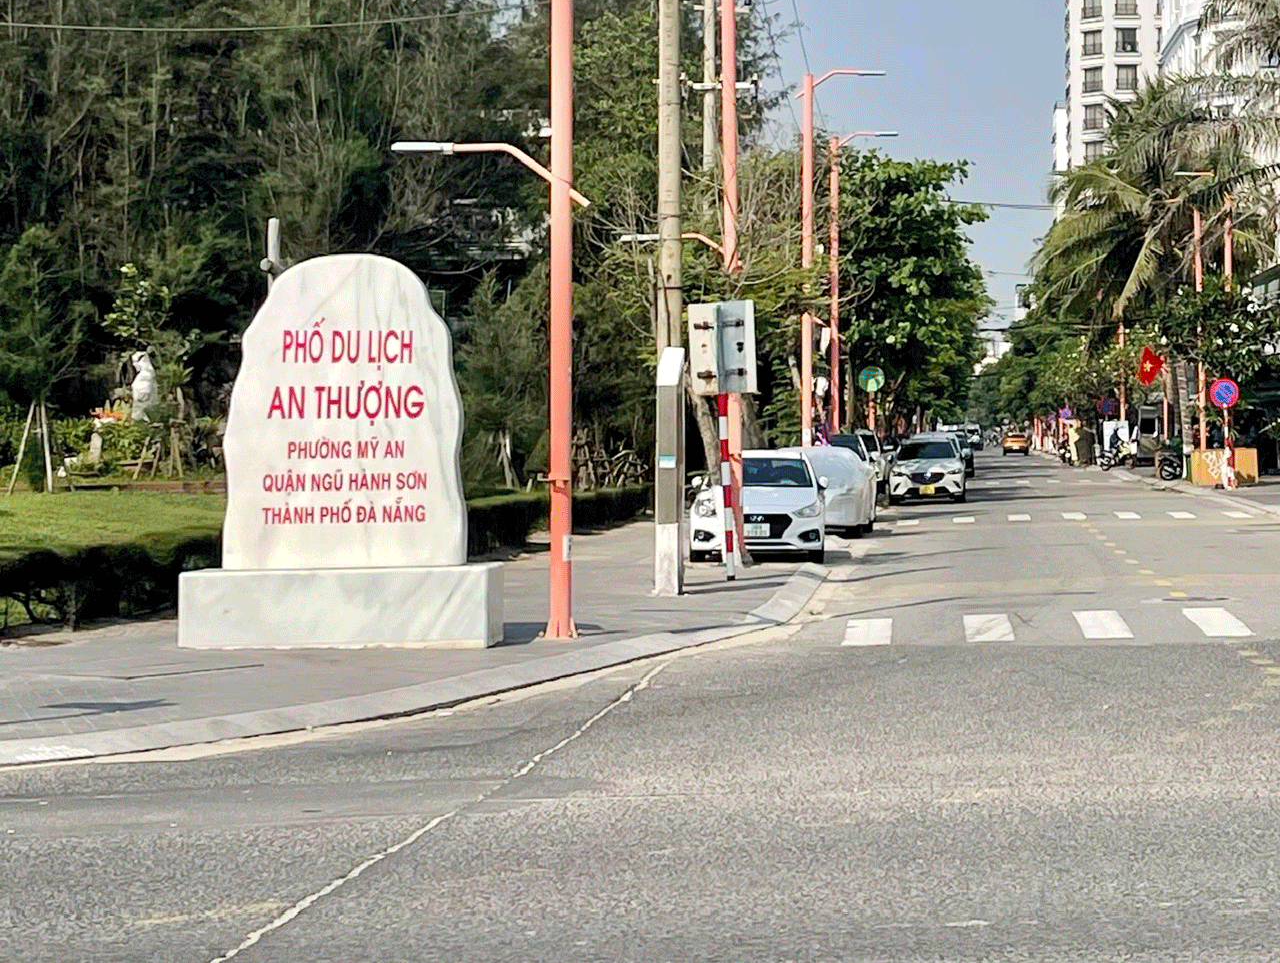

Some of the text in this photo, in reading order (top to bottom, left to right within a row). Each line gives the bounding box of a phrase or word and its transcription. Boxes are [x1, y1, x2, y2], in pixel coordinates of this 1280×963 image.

[282, 317, 414, 371] PHỐ DU LỊCH
[267, 380, 425, 426] AN THƯỢNG
[287, 436, 405, 460] PHƯỜNG MỸ AN
[262, 469, 428, 496] QUẬN NGŨ HÀNH SƠN
[262, 497, 427, 525] THÀNH PHỐ ĐÀ NẴNG
